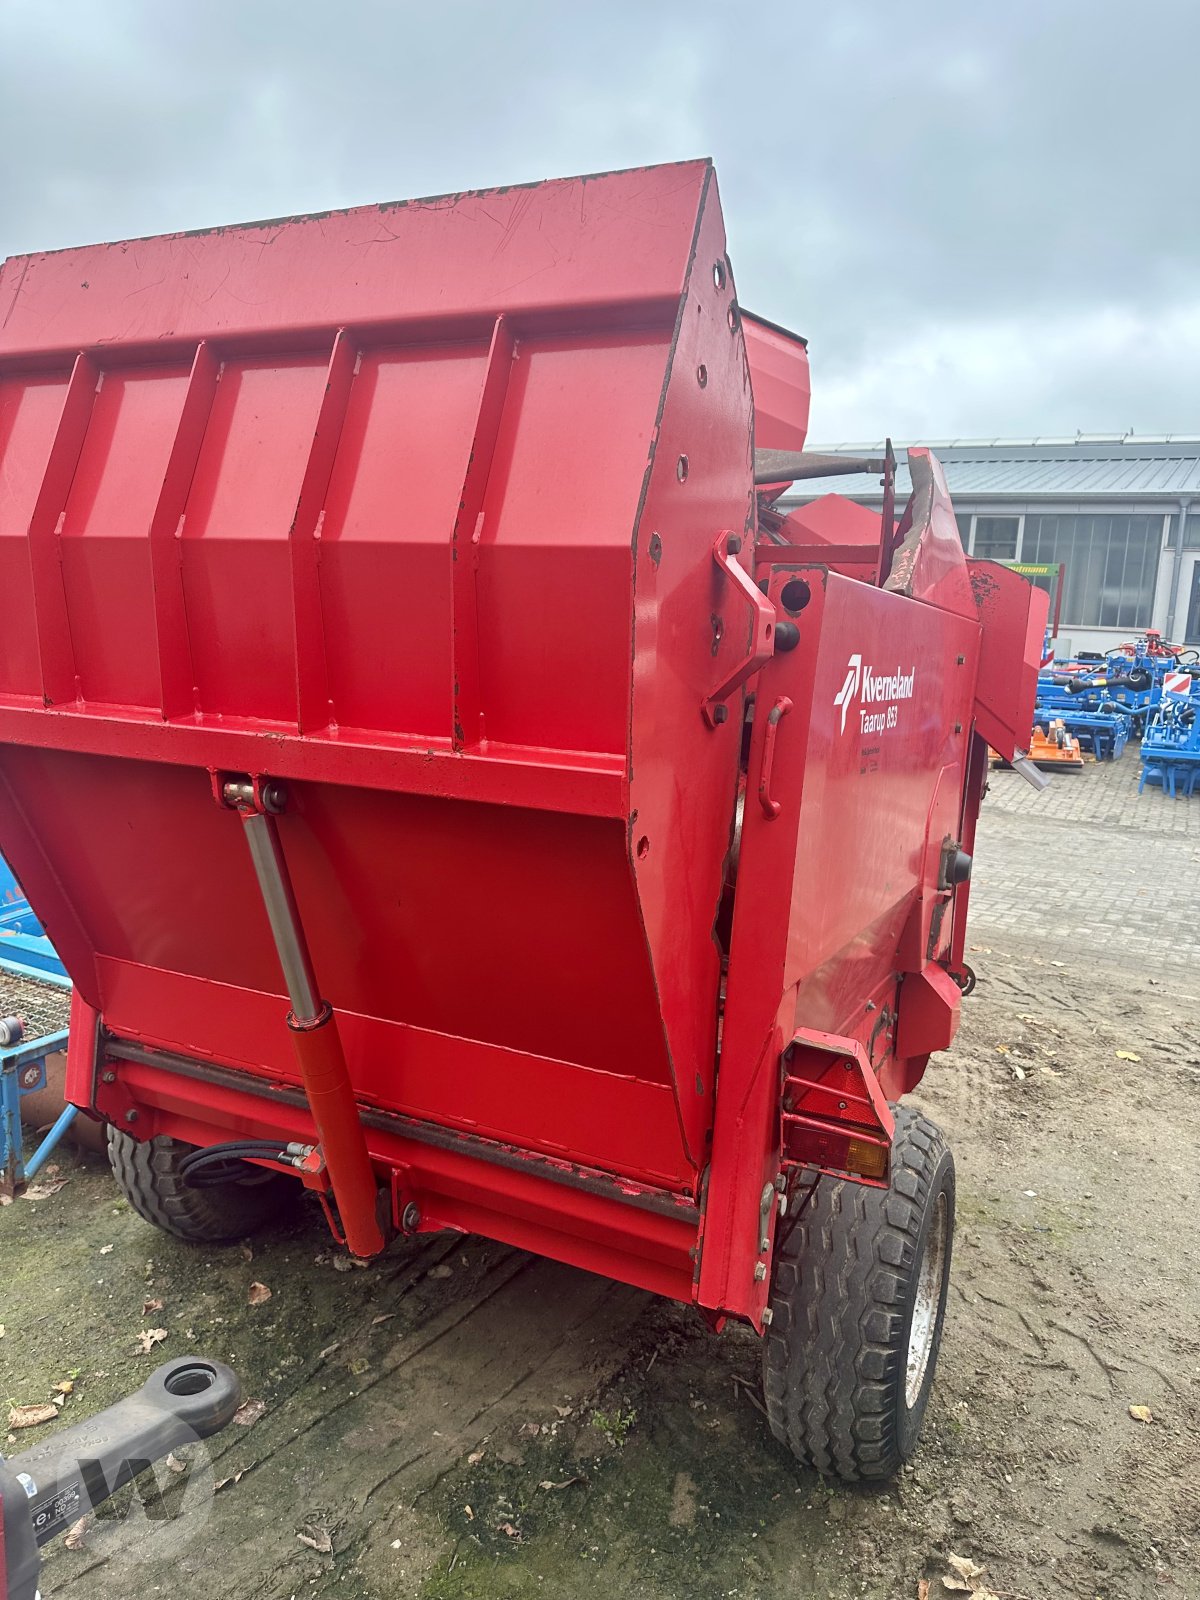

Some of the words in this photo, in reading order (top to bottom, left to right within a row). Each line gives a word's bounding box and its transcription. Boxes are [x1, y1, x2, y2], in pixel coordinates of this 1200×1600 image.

[861, 665, 915, 703] Kverneland
[860, 709, 886, 736] Taarup
[887, 705, 898, 728] 853
